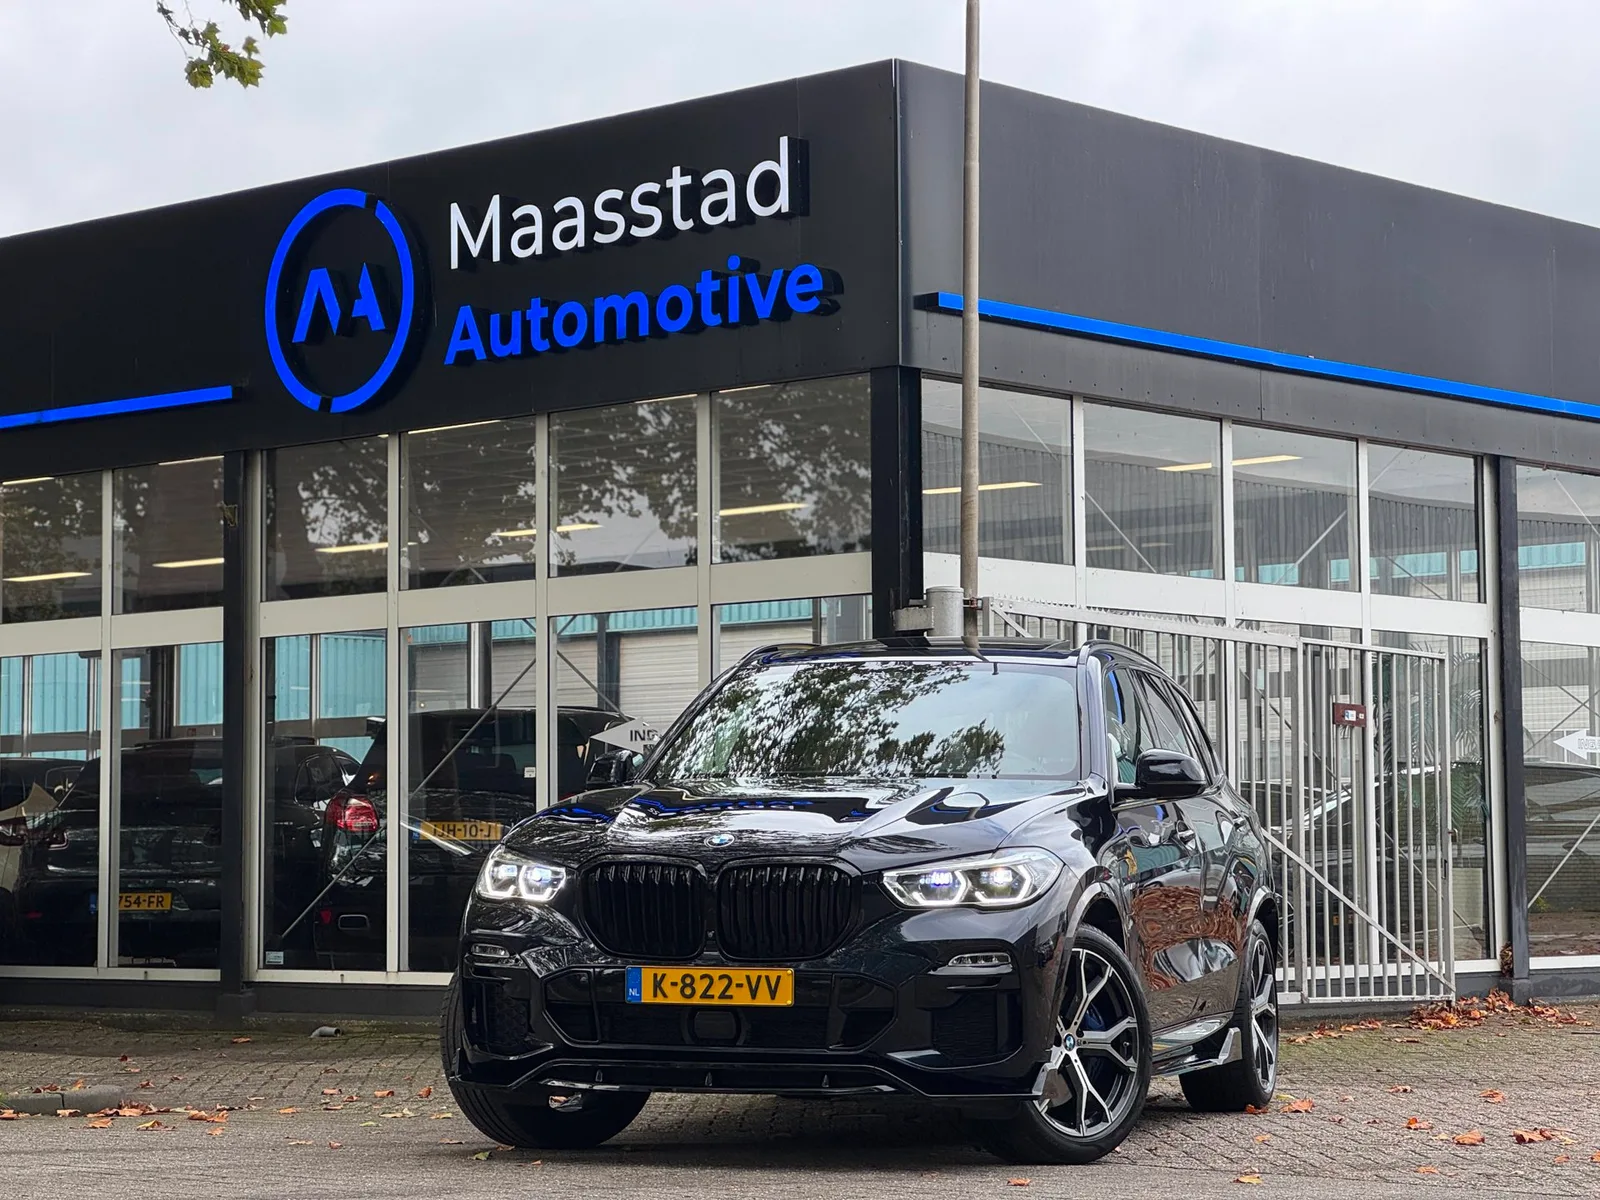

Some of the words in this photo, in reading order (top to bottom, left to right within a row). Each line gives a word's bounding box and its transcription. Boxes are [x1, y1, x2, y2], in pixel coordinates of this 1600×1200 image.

[449, 136, 790, 269] Maasstad
[444, 255, 823, 364] Automotive
[628, 988, 640, 996] NL
[652, 972, 781, 1001] K-822-VV
